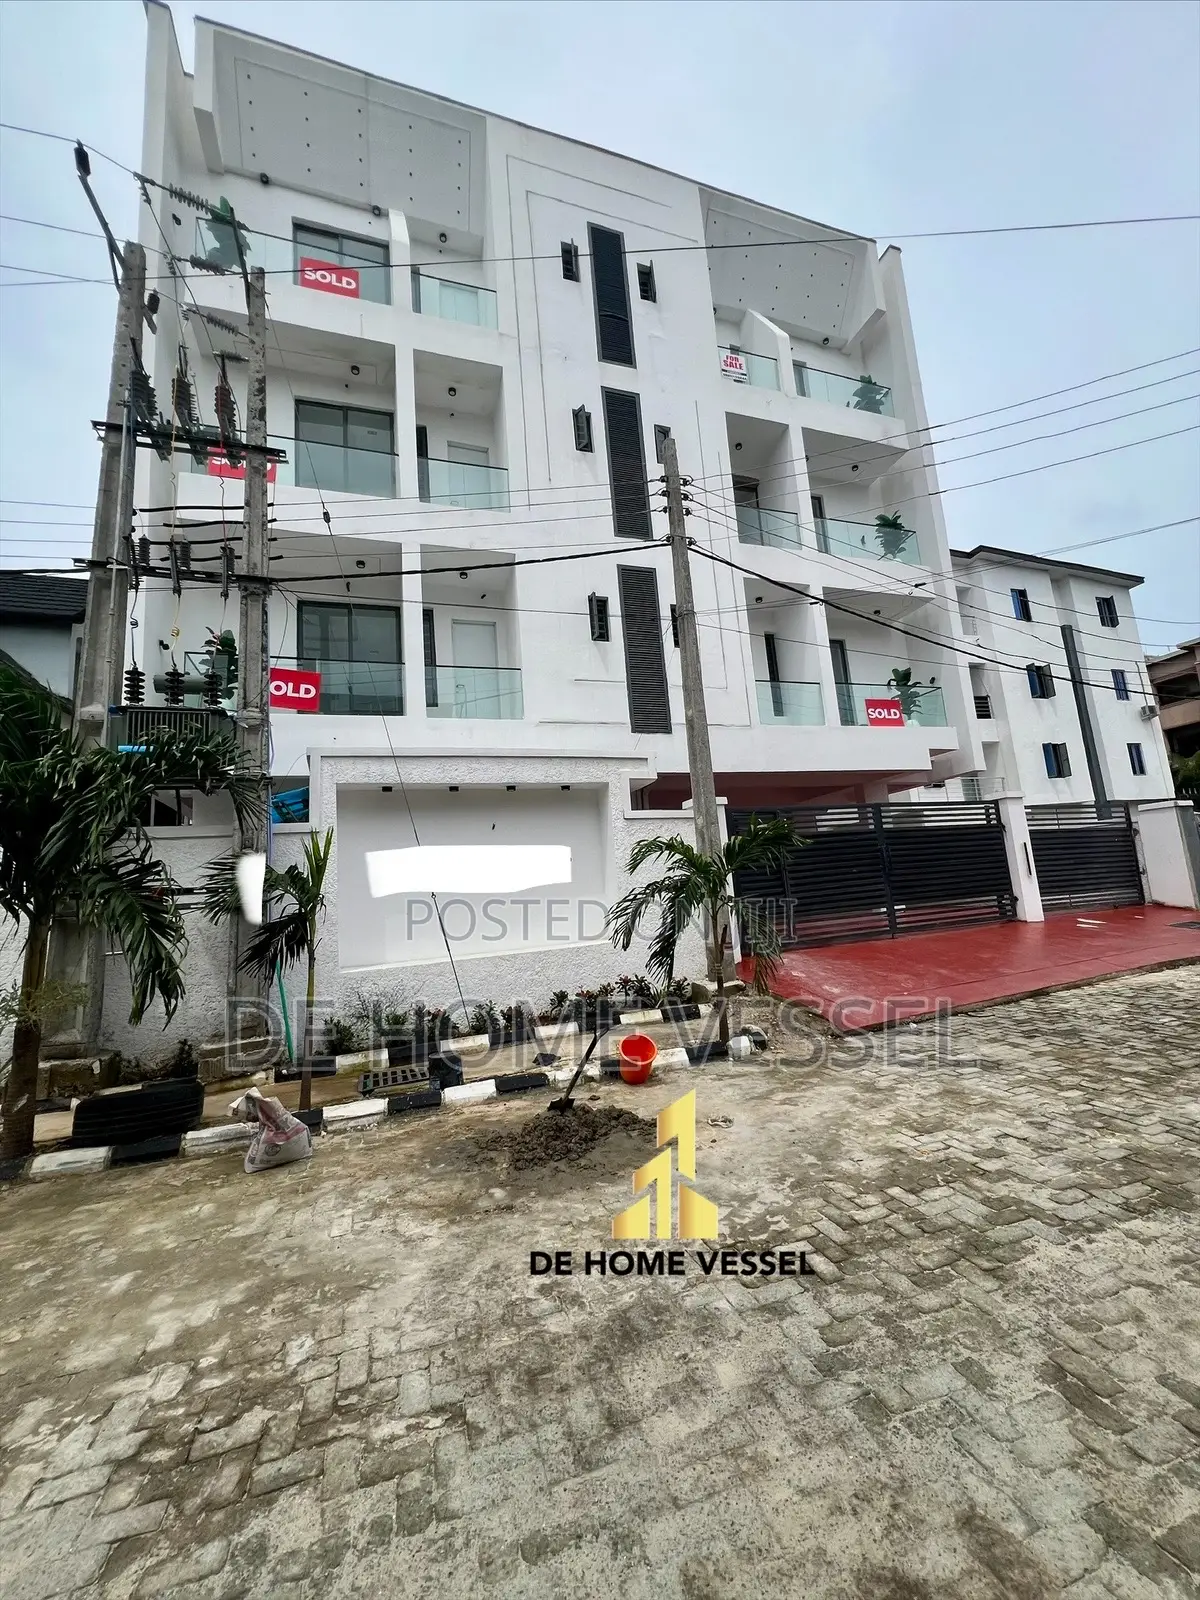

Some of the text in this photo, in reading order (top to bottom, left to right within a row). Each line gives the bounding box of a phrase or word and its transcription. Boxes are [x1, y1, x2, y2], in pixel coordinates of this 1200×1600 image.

[304, 267, 356, 289] SOLD
[723, 359, 743, 370] SALE
[725, 355, 739, 363] FOR
[270, 680, 316, 699] OLD
[867, 708, 900, 719] SOLD
